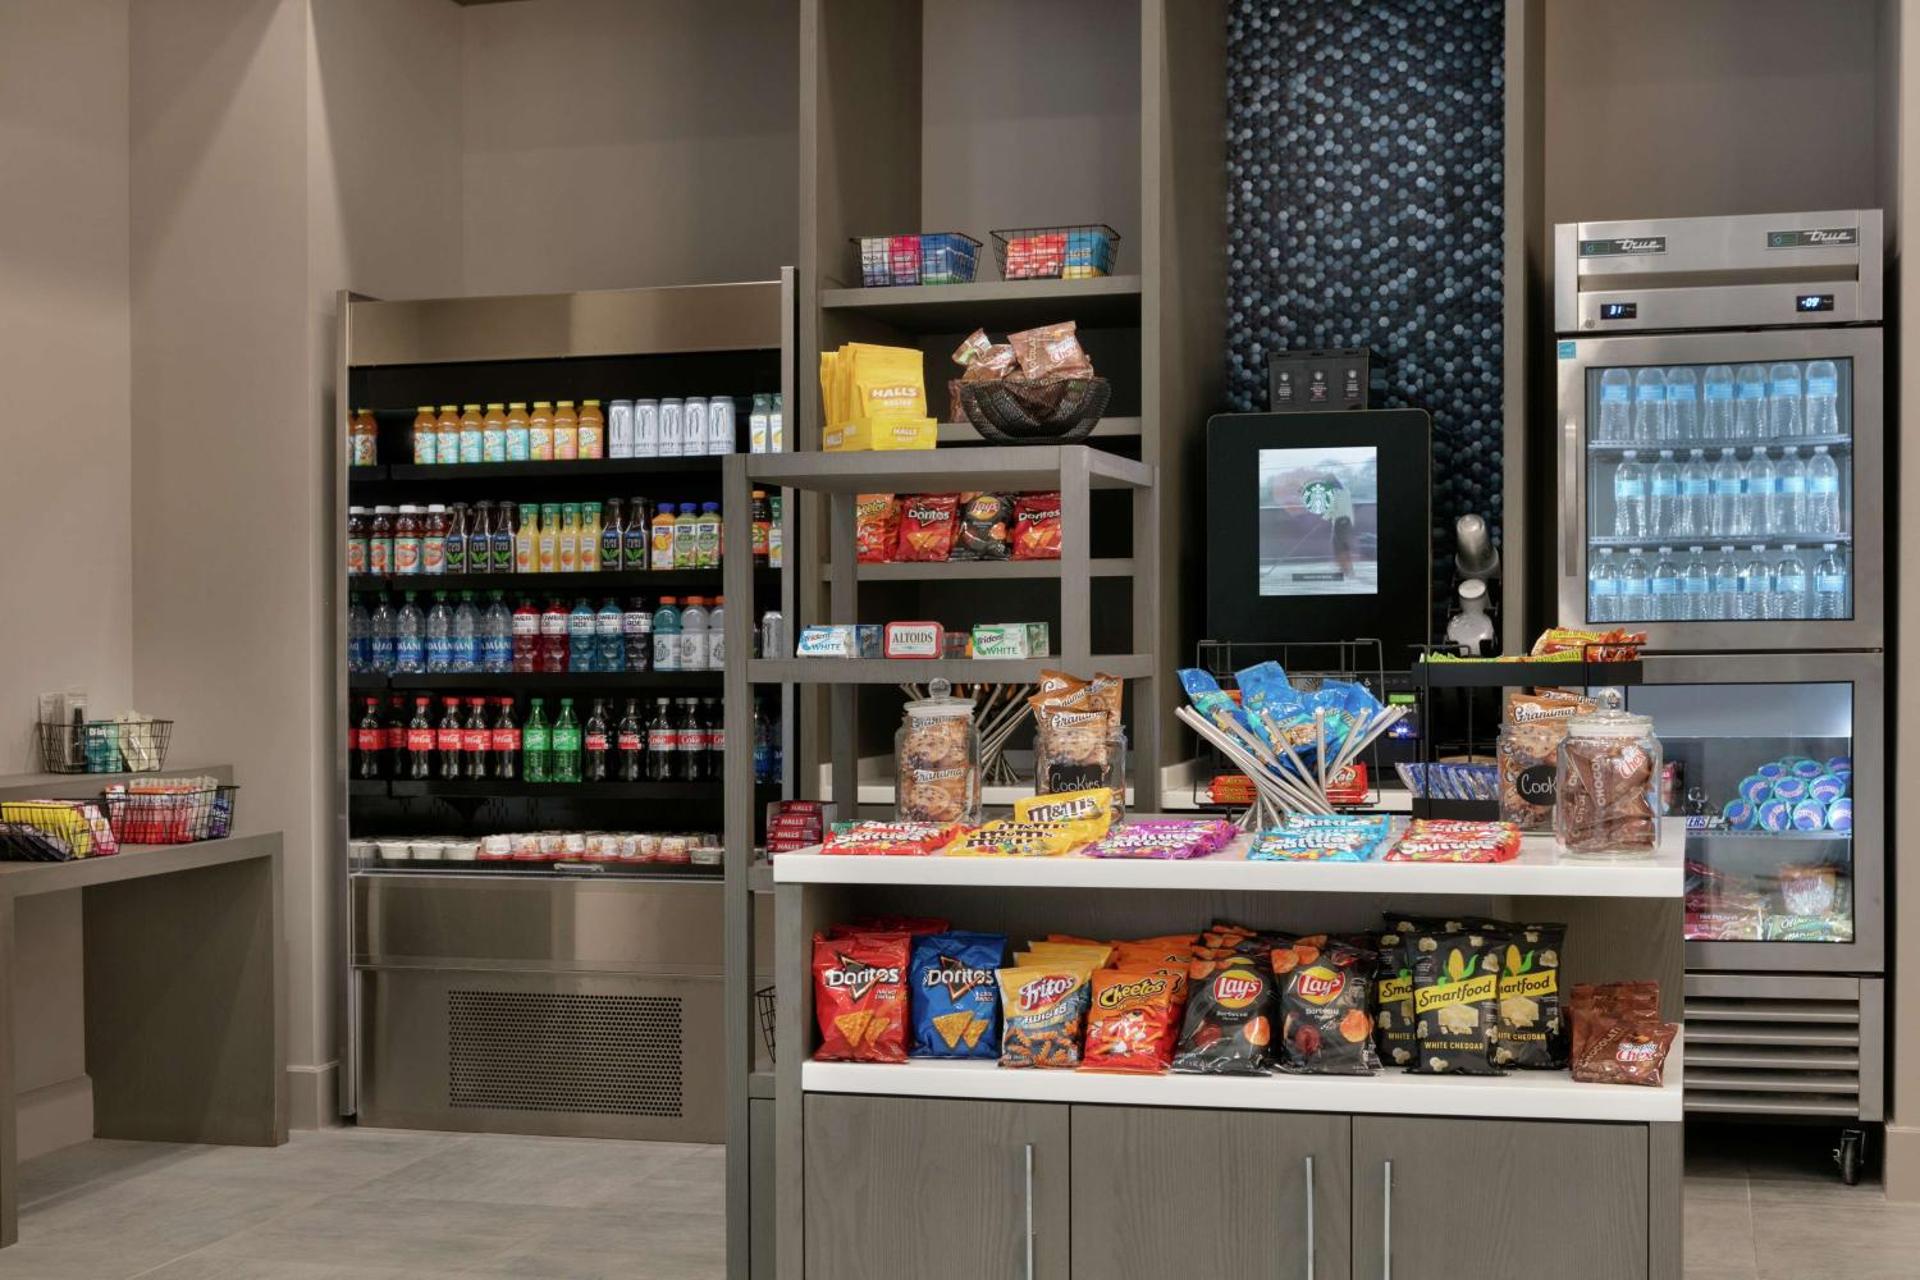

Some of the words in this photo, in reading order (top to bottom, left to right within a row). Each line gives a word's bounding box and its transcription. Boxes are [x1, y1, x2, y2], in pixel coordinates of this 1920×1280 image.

[1804, 231, 1851, 241] True
[1615, 239, 1662, 250] True
[872, 387, 917, 398] HALLS
[908, 509, 950, 520] Doritos
[892, 631, 933, 644] ALTOIDS
[986, 647, 1019, 655] WHITE
[825, 967, 900, 987] Doritos
[925, 968, 994, 986] Doritos
[1020, 975, 1077, 1010] Fritos
[1100, 978, 1167, 1007] Cheetos
[1218, 977, 1262, 1000] Lay's
[1419, 981, 1492, 1007] Smartfood
[1513, 1033, 1546, 1041] CHEDDAR
[1424, 1041, 1449, 1050] WHITE
[1450, 1041, 1484, 1050] CHEDDAR
